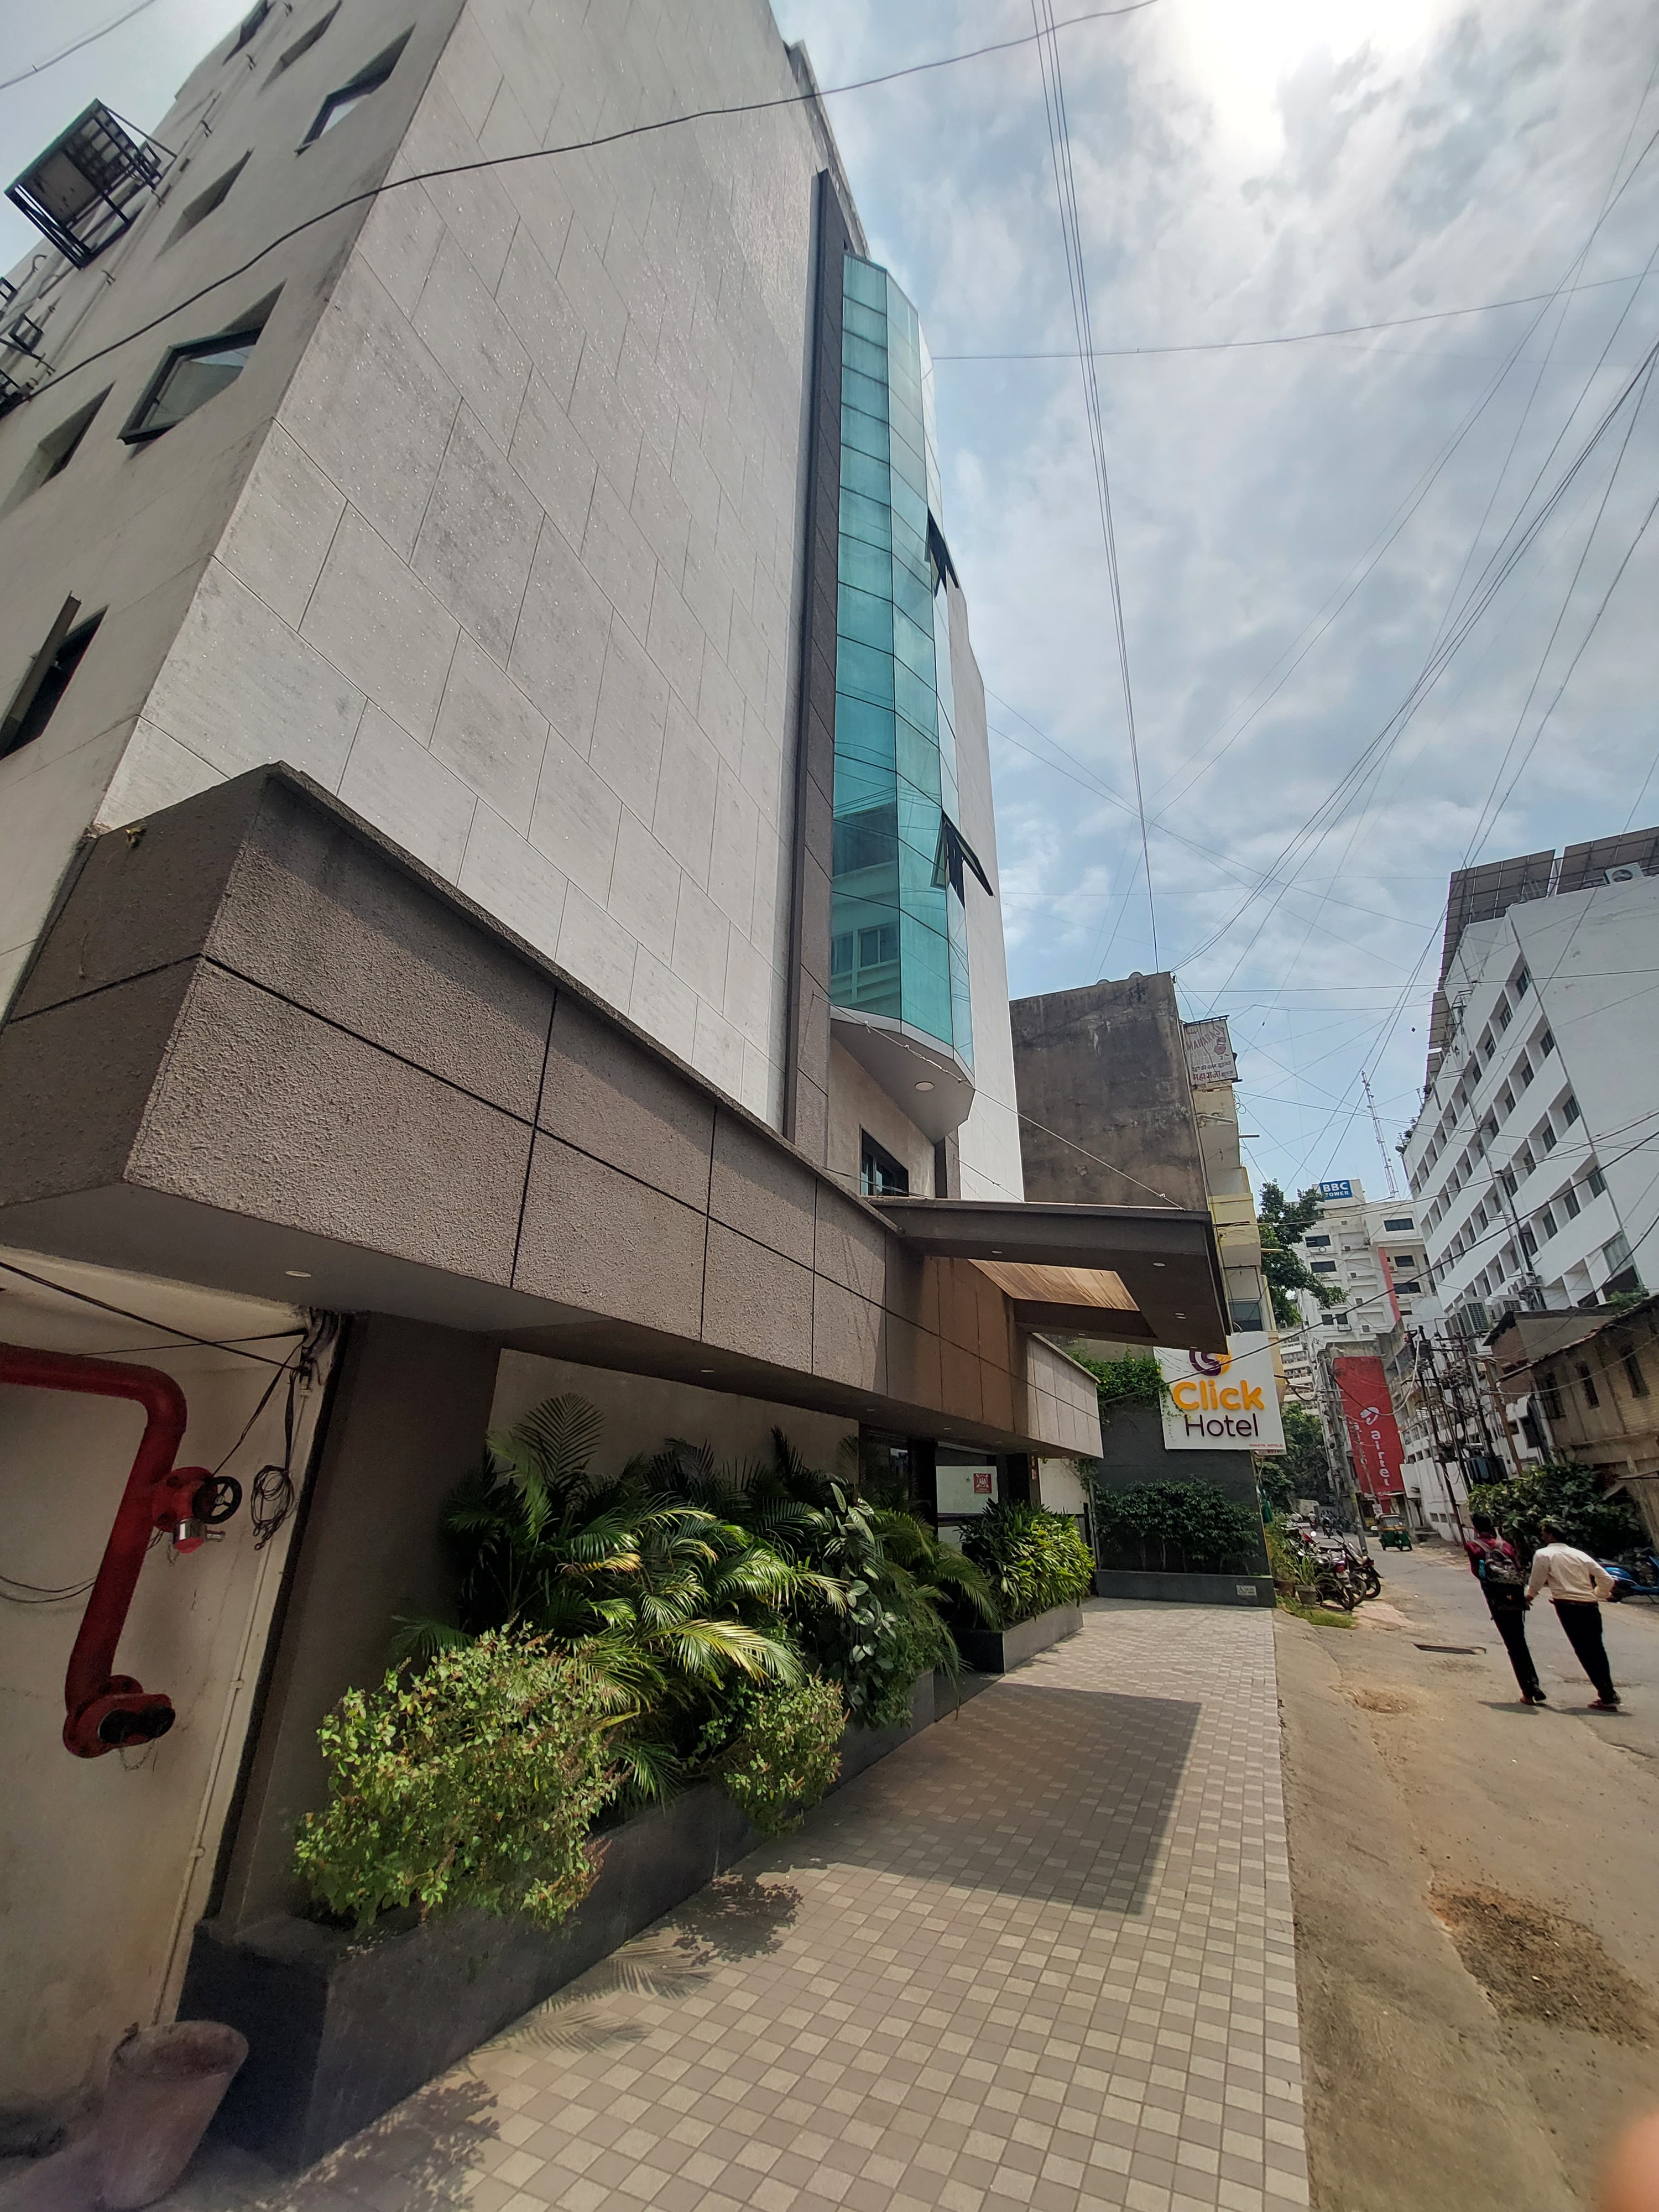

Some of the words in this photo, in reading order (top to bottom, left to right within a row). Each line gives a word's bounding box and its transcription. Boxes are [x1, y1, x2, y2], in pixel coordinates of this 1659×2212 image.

[1186, 1025, 1224, 1051] MAHARAJA
[1322, 1182, 1349, 1192] BBC
[1173, 1379, 1265, 1410] Click
[1185, 1413, 1259, 1437] Hotel
[1370, 1430, 1390, 1486] airtel
